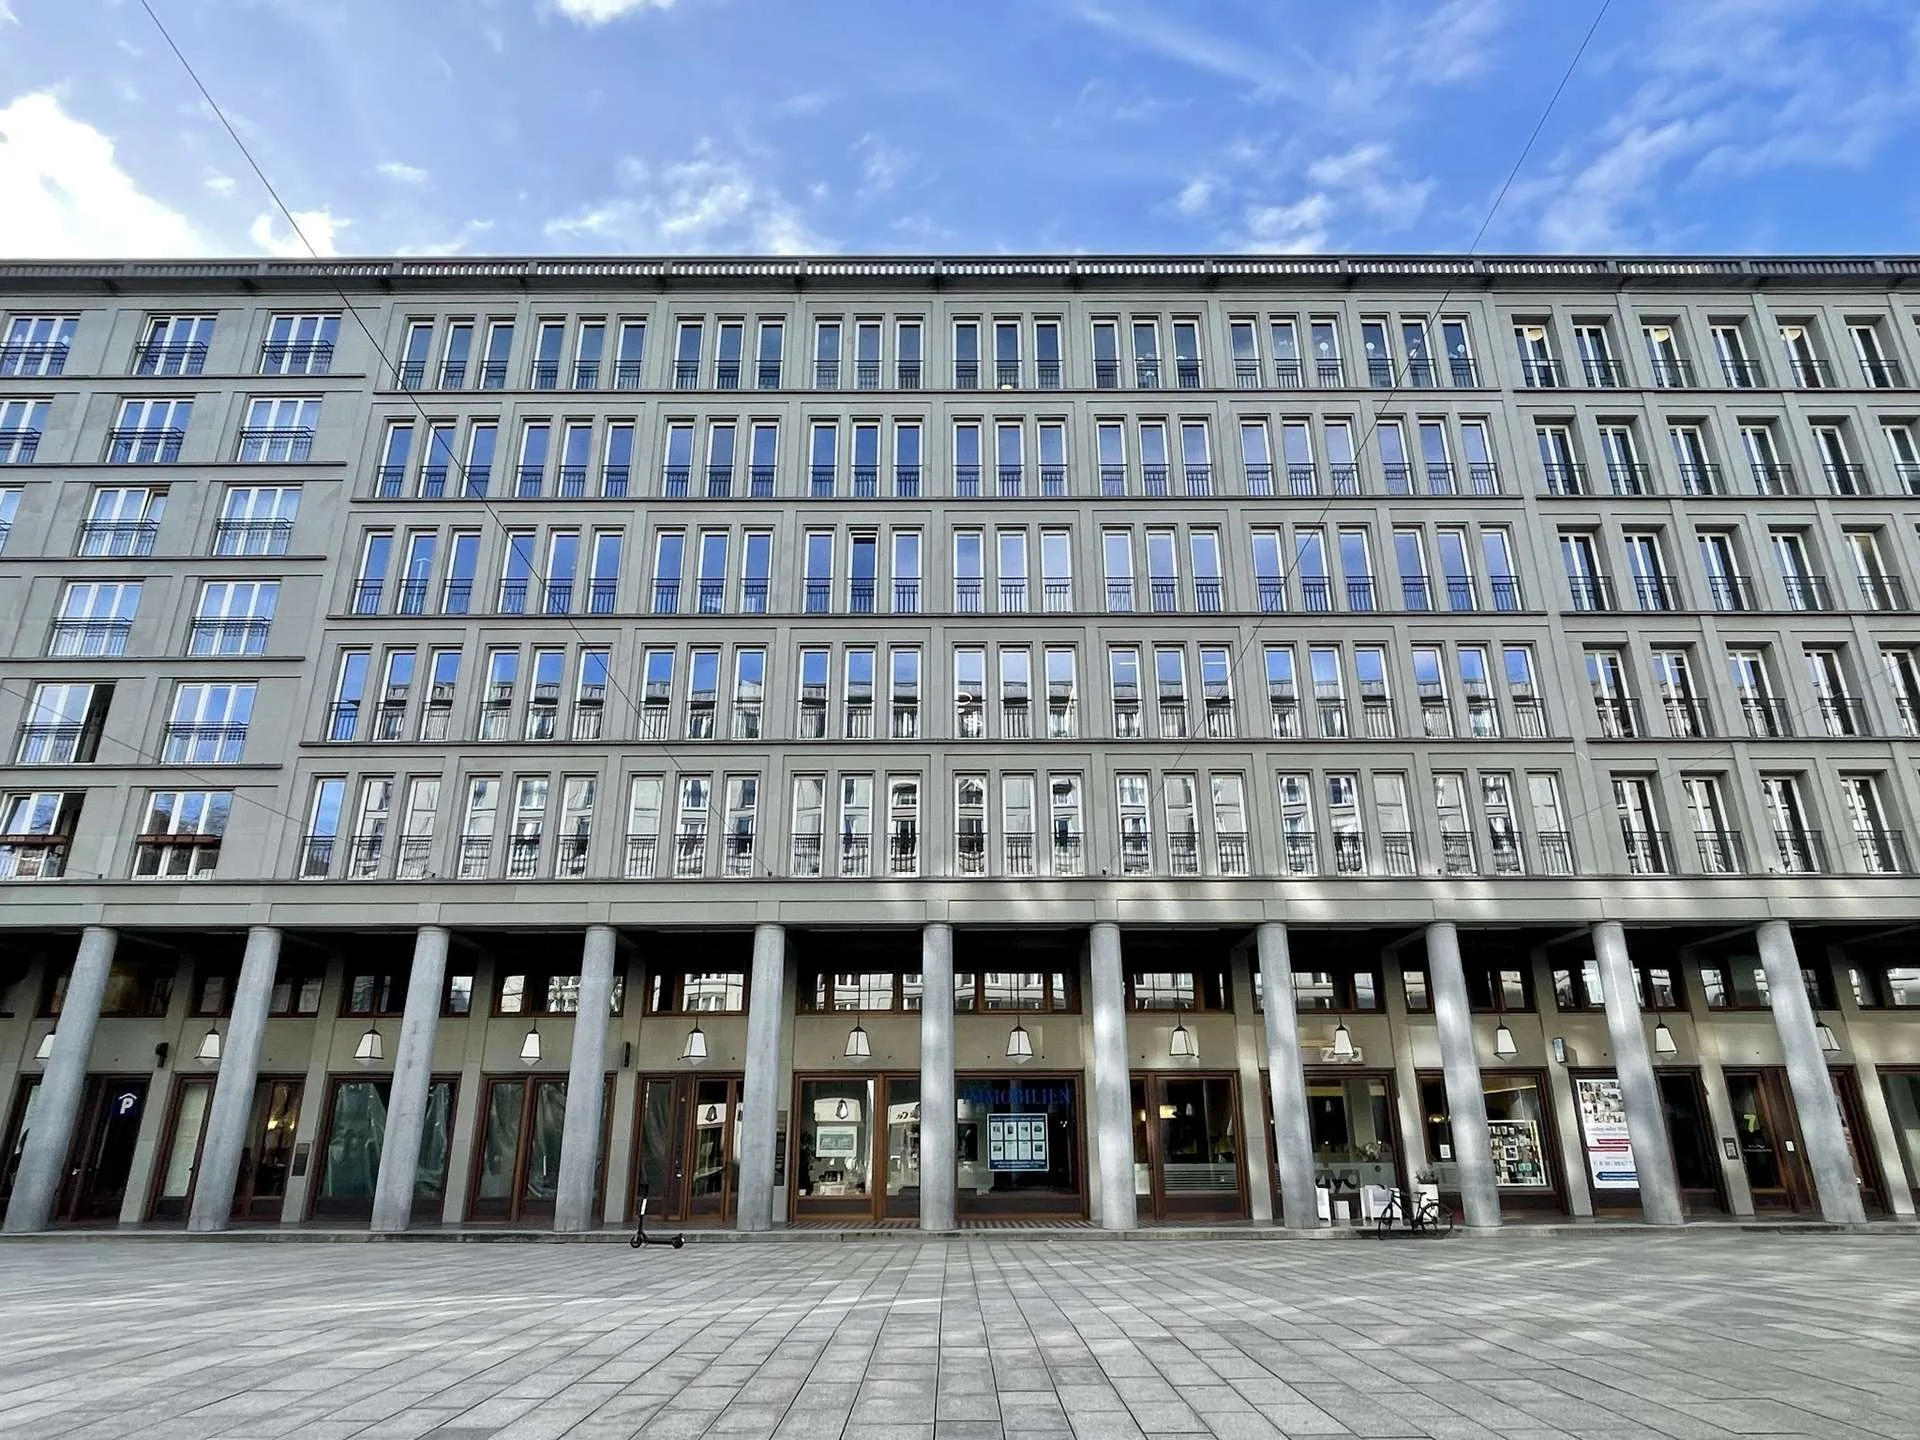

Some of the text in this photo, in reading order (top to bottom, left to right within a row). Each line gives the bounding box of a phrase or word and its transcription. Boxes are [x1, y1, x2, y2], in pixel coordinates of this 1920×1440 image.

[960, 1087, 1071, 1105] IMMOBILIEN
[120, 1097, 134, 1115] P
[1744, 1114, 1756, 1133] 7
